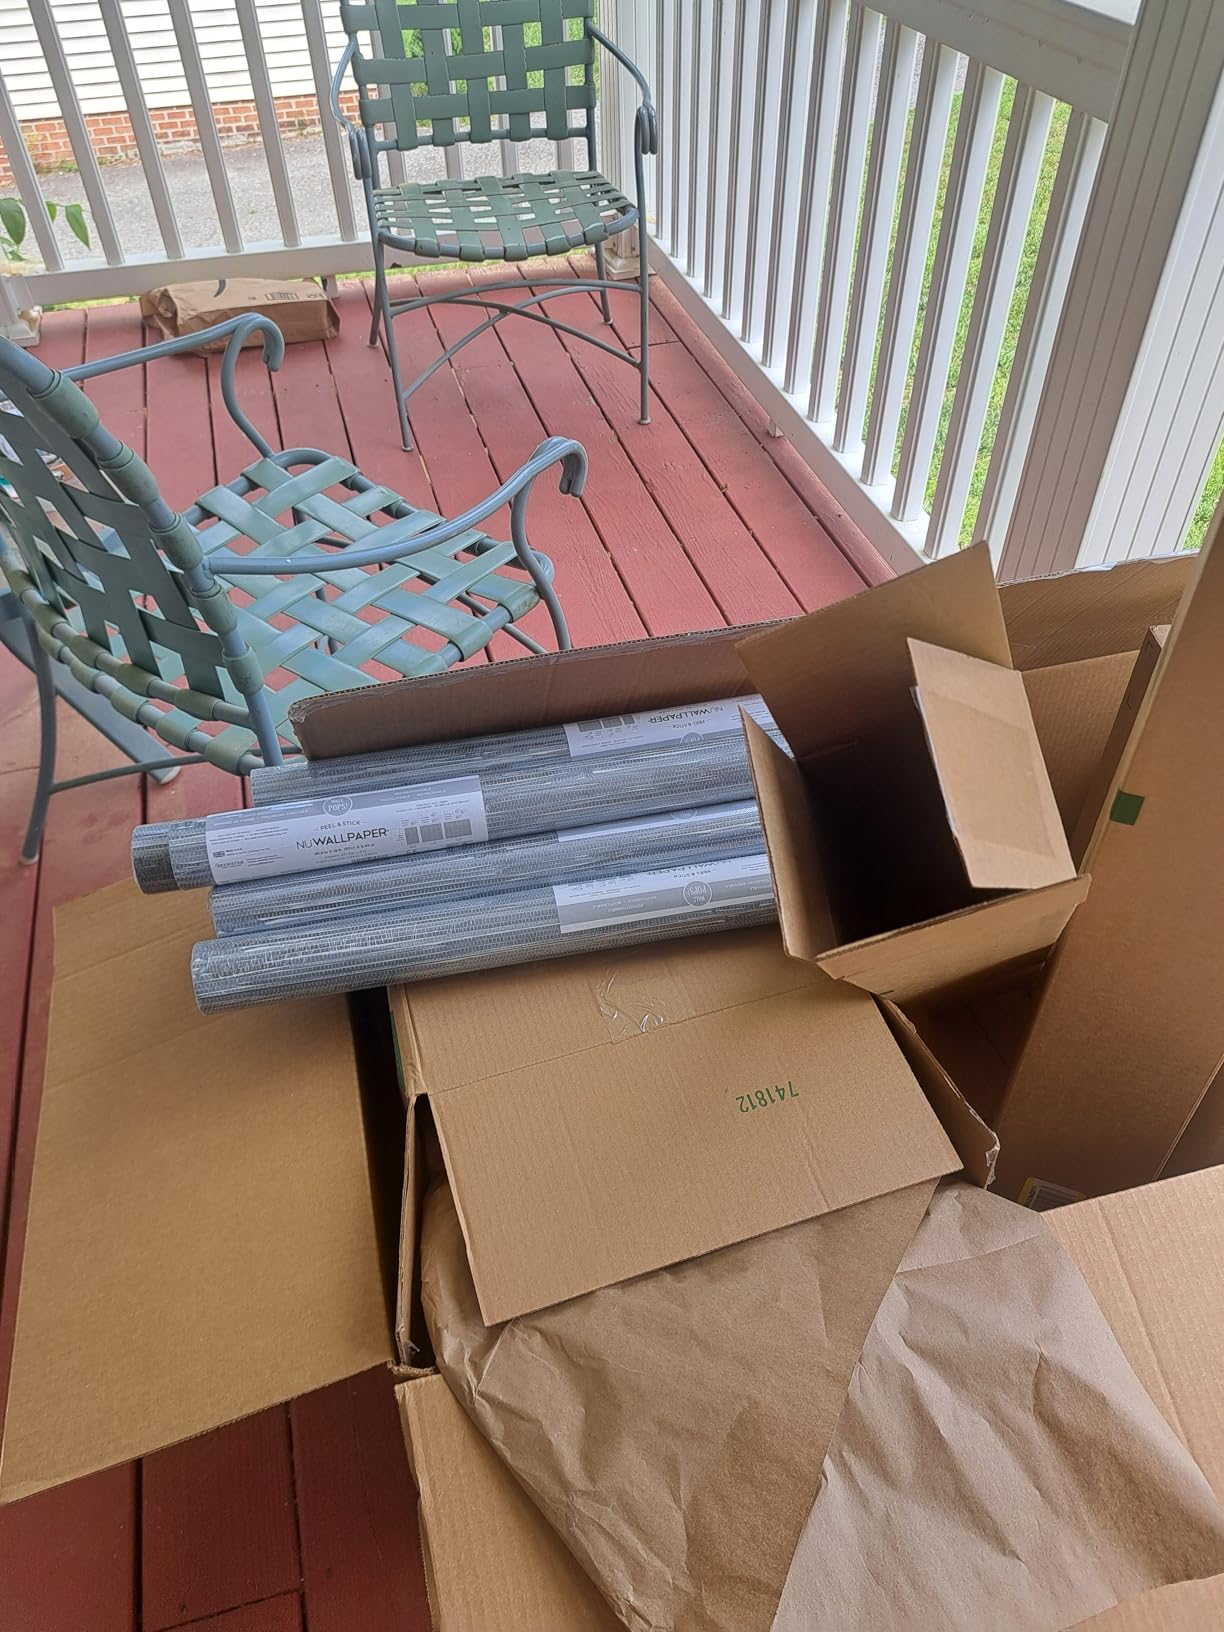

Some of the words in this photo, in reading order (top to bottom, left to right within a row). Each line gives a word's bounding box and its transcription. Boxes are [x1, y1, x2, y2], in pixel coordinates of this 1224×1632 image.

[648, 705, 724, 724] NUWALLPAPER
[327, 803, 348, 812] POPS!
[320, 823, 337, 831] PEEL
[296, 827, 388, 850] NUWALLPAPER
[686, 884, 707, 896] POPS!
[735, 1080, 800, 1113] 741812
